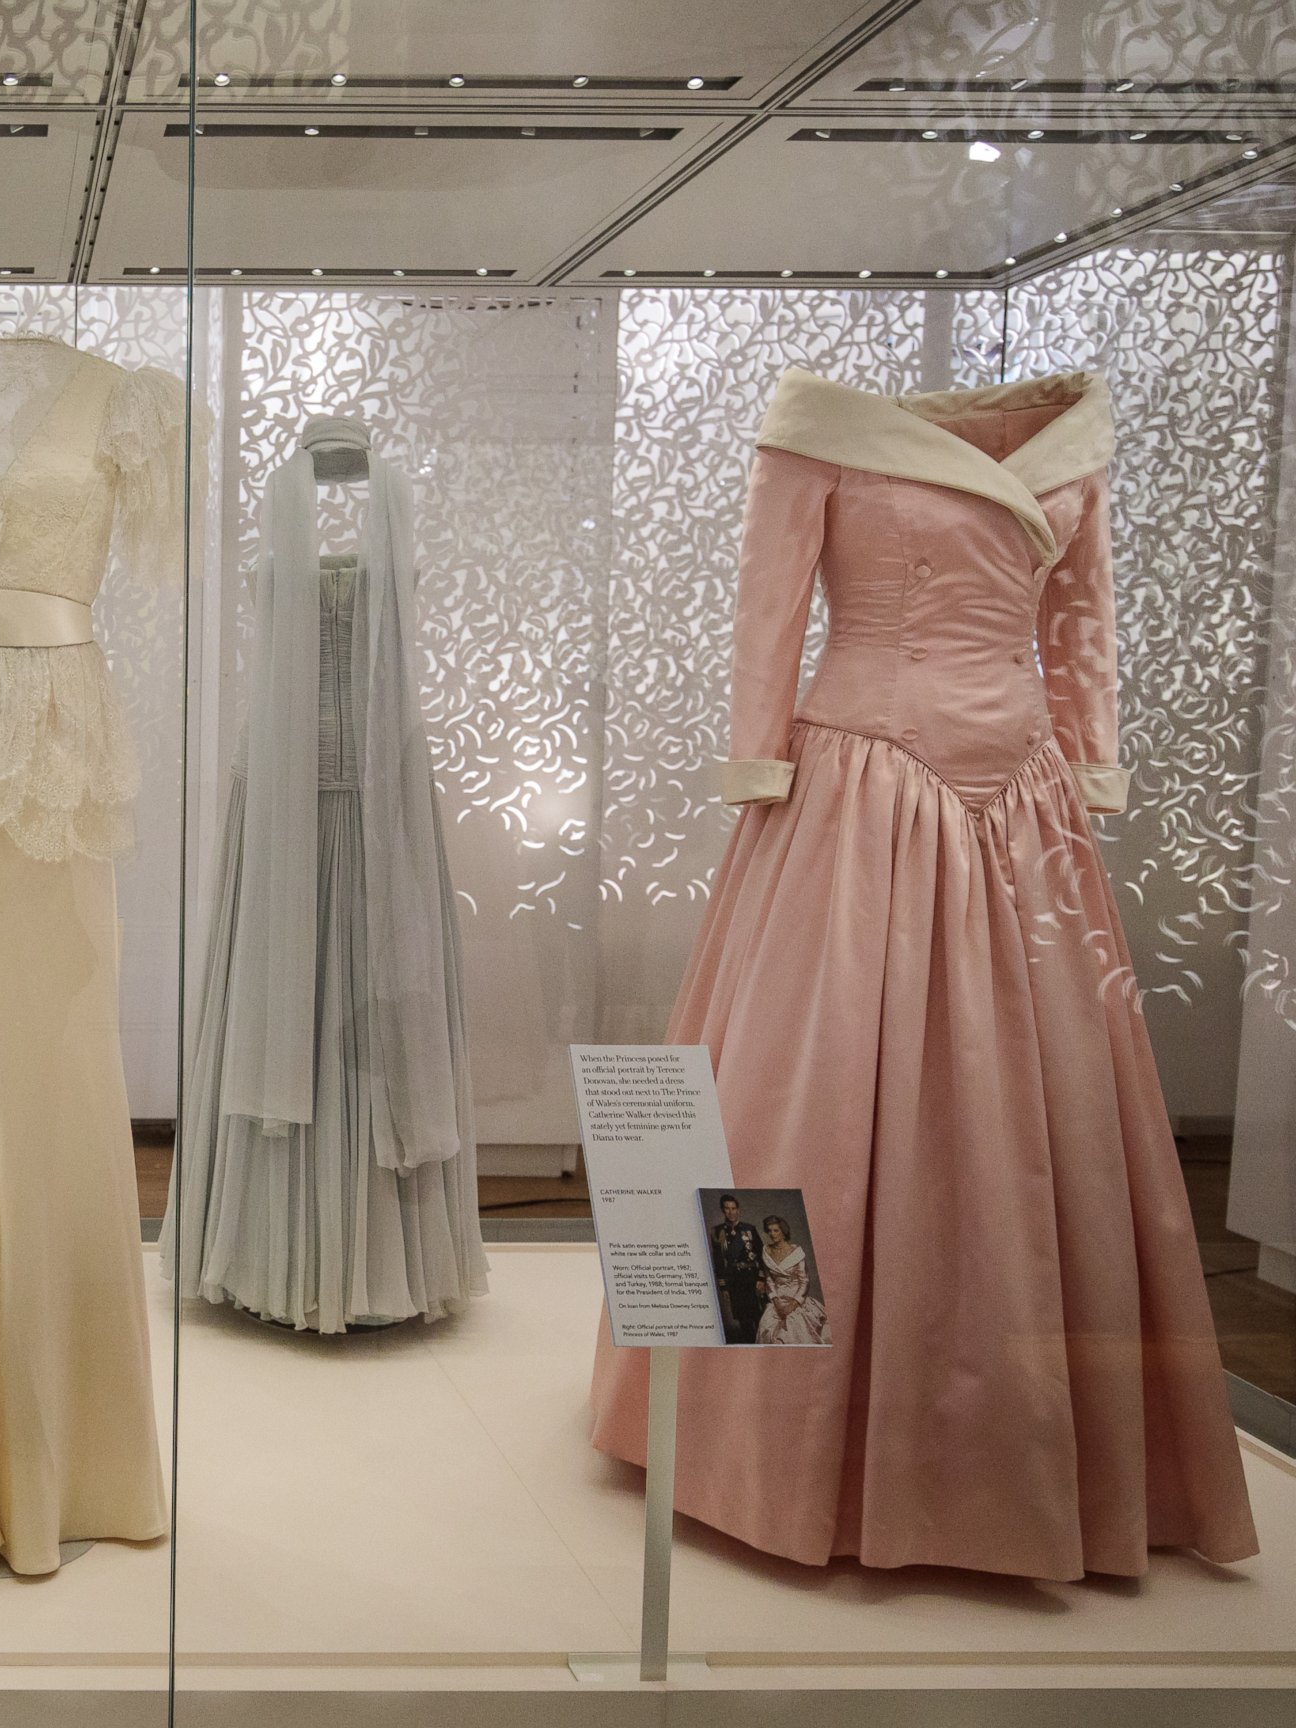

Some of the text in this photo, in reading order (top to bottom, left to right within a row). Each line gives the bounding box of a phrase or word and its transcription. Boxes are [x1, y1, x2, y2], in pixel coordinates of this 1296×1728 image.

[647, 1055, 669, 1064] posed
[617, 1066, 645, 1075] portrait
[646, 1066, 655, 1075] by
[583, 1077, 618, 1085] Donovan,
[585, 1088, 701, 1096] that stood out next to The Prince
[586, 1099, 595, 1107] of
[622, 1099, 662, 1107] ceremonial
[663, 1099, 696, 1107] uniform.
[588, 1111, 697, 1119] Catherine Walker devised this
[590, 1122, 692, 1132] stately yet feminine gown for
[592, 1133, 614, 1141] Diana
[615, 1133, 623, 1141] to
[636, 1242, 660, 1250] evening
